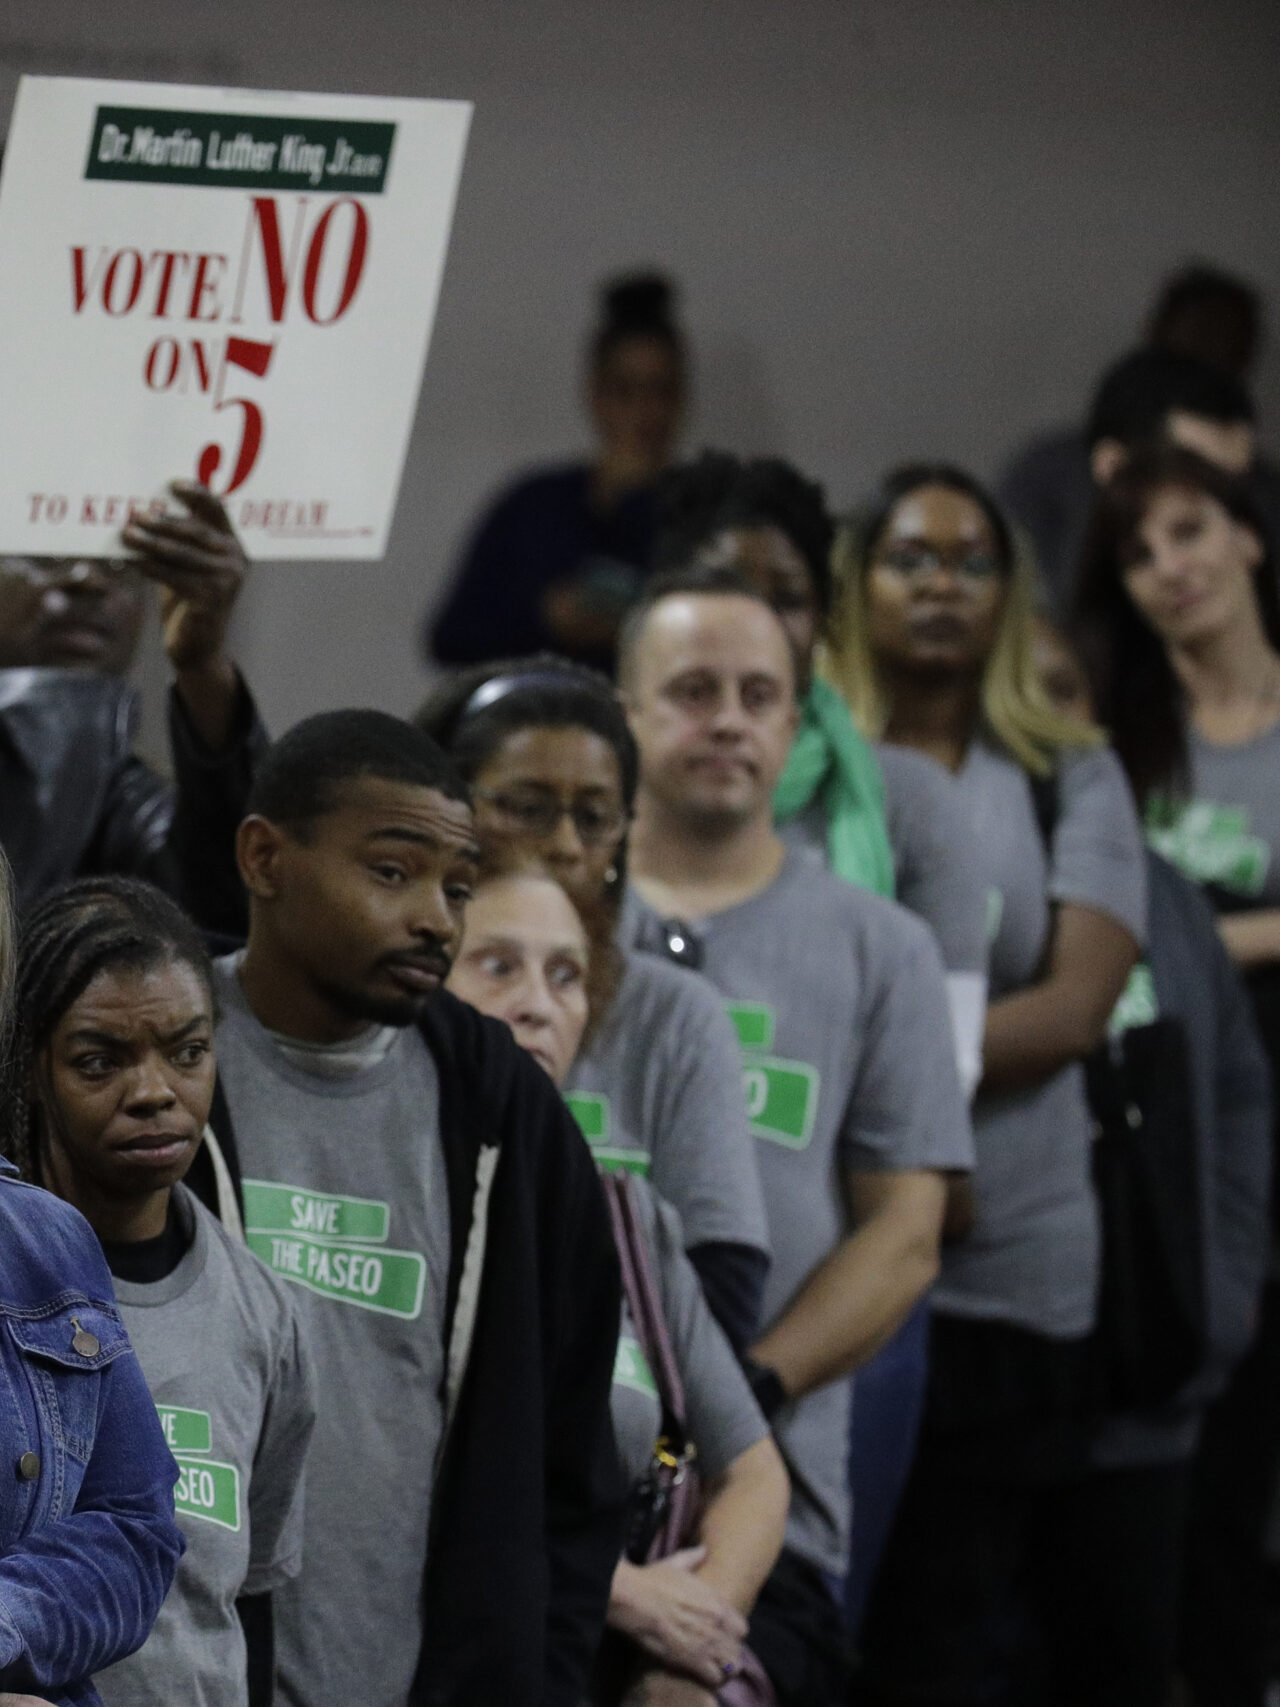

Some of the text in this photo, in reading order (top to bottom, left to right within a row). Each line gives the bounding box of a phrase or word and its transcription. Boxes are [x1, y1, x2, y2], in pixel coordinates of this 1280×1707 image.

[206, 130, 278, 172] Luther
[278, 133, 326, 186] King
[69, 196, 371, 327] VOTE NO
[145, 334, 277, 498] ON 5
[27, 493, 68, 525] TO
[291, 1195, 341, 1234] SAVE
[271, 1239, 383, 1297] THE PASEO
